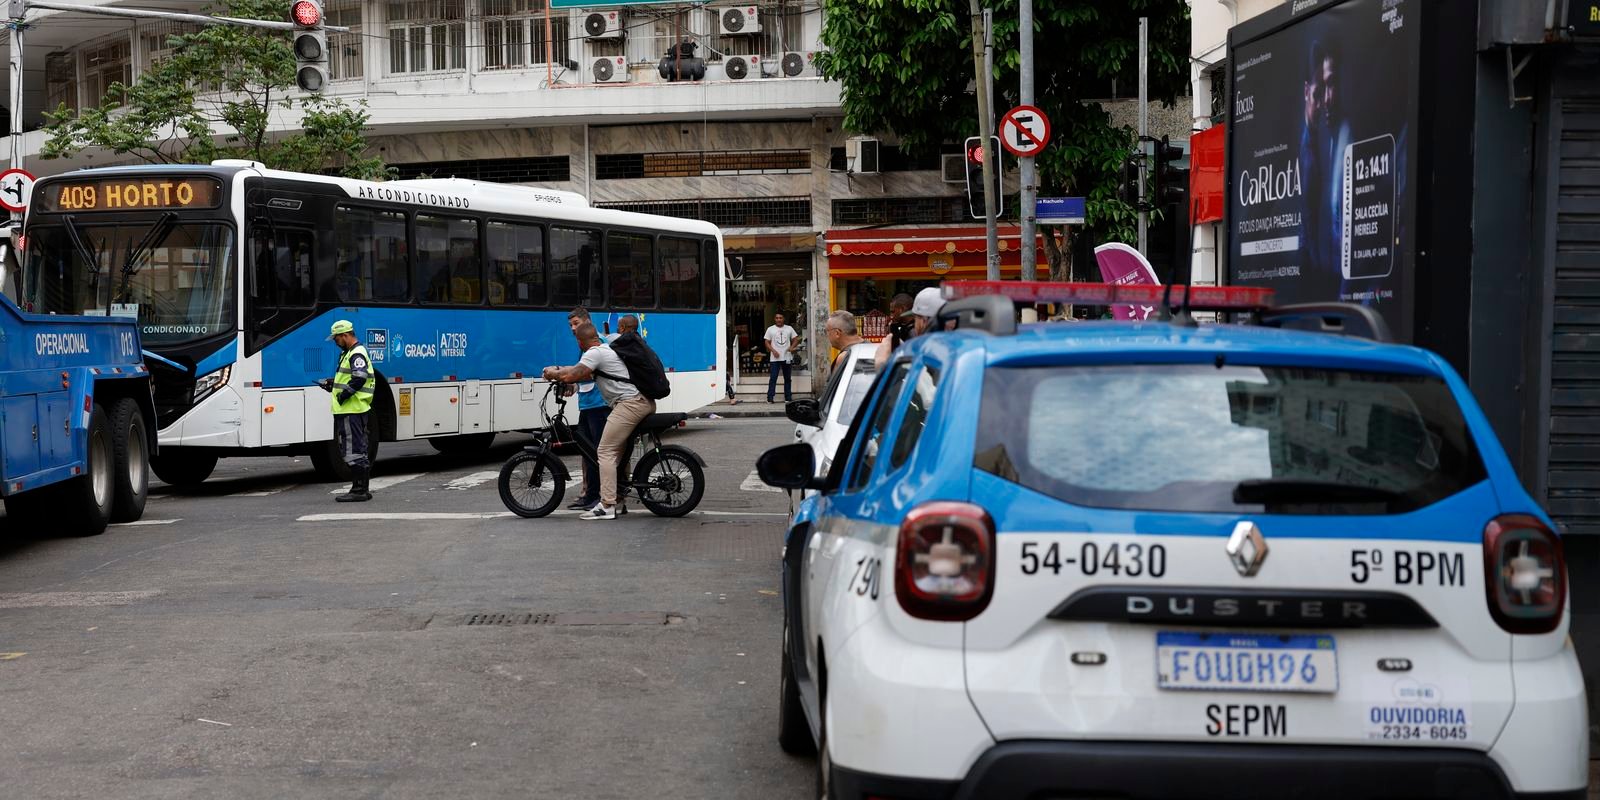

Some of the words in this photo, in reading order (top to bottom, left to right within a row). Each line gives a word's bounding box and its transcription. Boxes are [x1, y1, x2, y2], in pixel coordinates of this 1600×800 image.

[1236, 90, 1254, 116] focus
[1355, 158, 1364, 180] 12
[1364, 165, 1370, 179] a
[1369, 152, 1389, 178] 14.11
[60, 186, 96, 209] 409
[105, 182, 194, 208] HORTO
[358, 186, 374, 198] AR
[377, 188, 470, 209] CONDICIONADO
[1354, 206, 1368, 220] SALA
[1239, 219, 1255, 234] FOCUS
[1255, 216, 1273, 232] DANÇA
[1344, 220, 1350, 238] DE
[1354, 221, 1378, 236] MEIRELES
[143, 325, 208, 335] CONDICIONADO
[374, 333, 386, 343] Rio
[35, 333, 90, 356] OPERACIONAL
[120, 332, 134, 356] 013
[440, 333, 468, 349] A71518
[405, 344, 436, 359] GRAÇAS
[441, 349, 467, 357] INTERSUL
[1020, 541, 1168, 579] 54-0430
[1393, 550, 1466, 588] BPM
[848, 555, 882, 601] 190
[1126, 596, 1367, 618] DUSTER
[1206, 704, 1287, 736] SEPM
[1370, 706, 1467, 725] OUVIDORIA
[1383, 725, 1468, 740] 2334-6045
